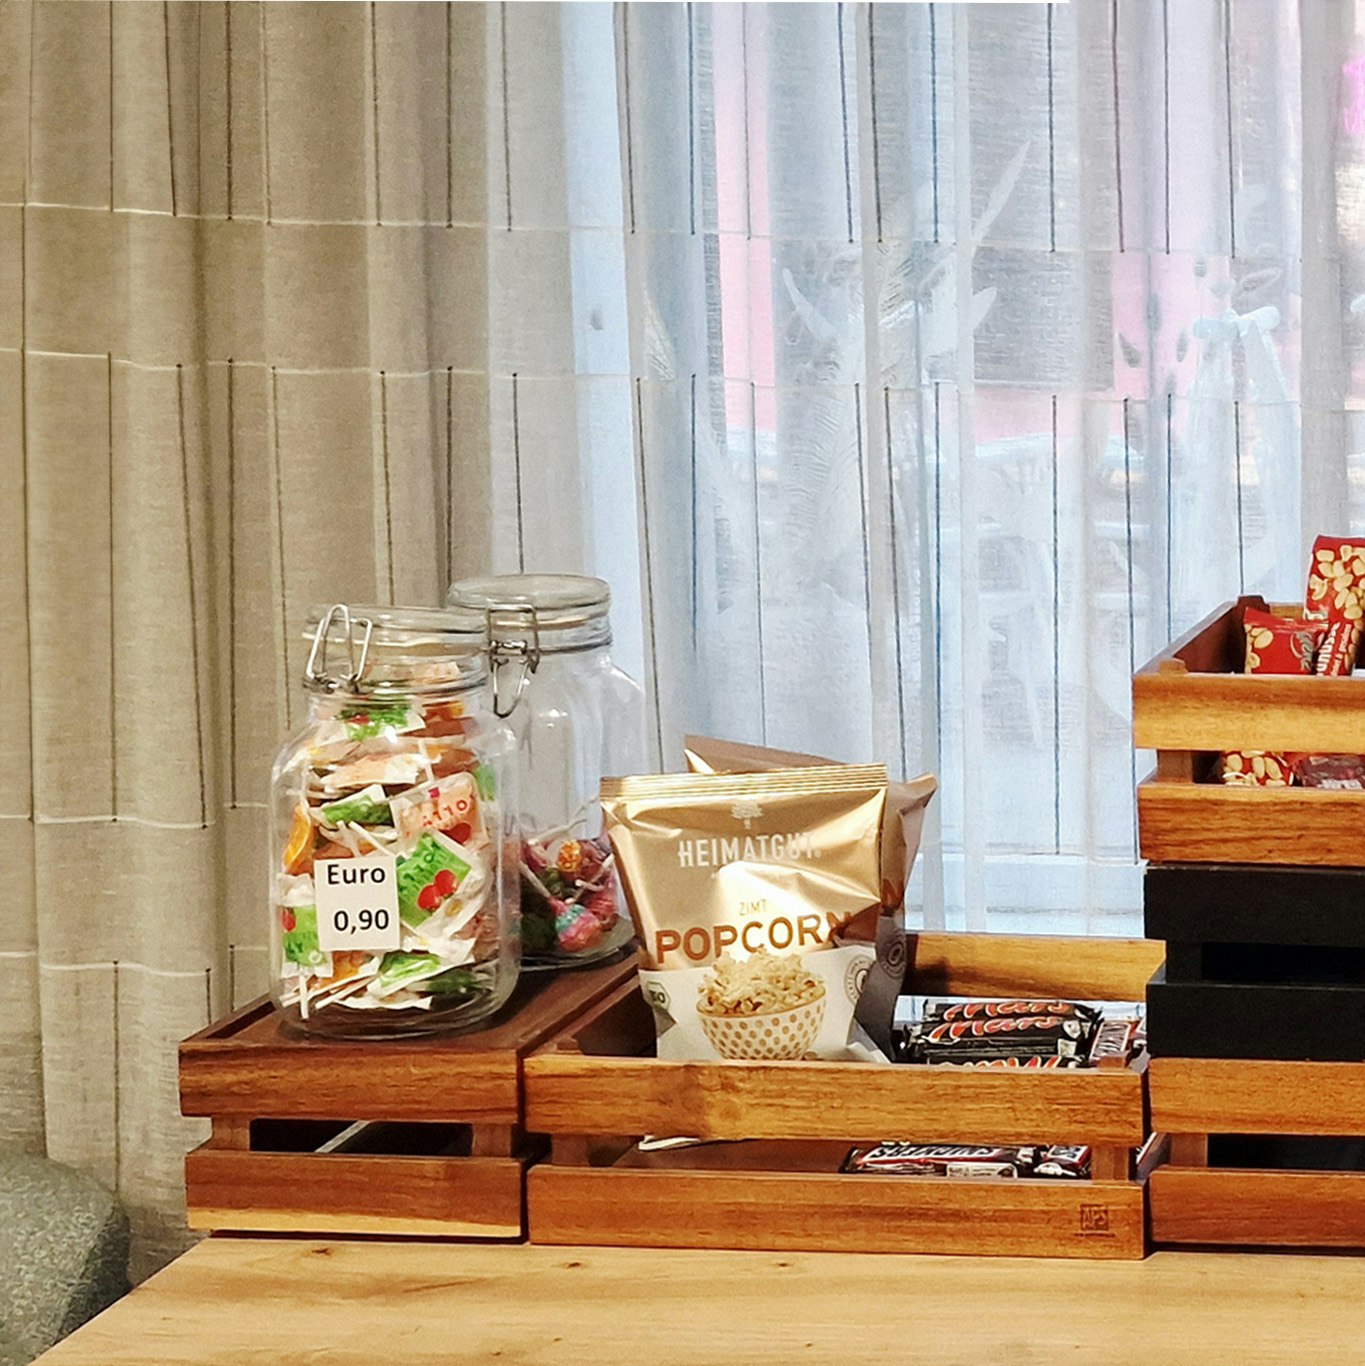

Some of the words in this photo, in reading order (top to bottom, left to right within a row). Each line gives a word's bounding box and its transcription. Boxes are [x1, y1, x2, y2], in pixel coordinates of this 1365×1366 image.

[678, 831, 816, 868] HEIMATGUT
[326, 864, 386, 886] Euro
[333, 908, 390, 935] 0,90
[738, 899, 768, 917] ZIMT
[655, 911, 851, 964] POPCORN
